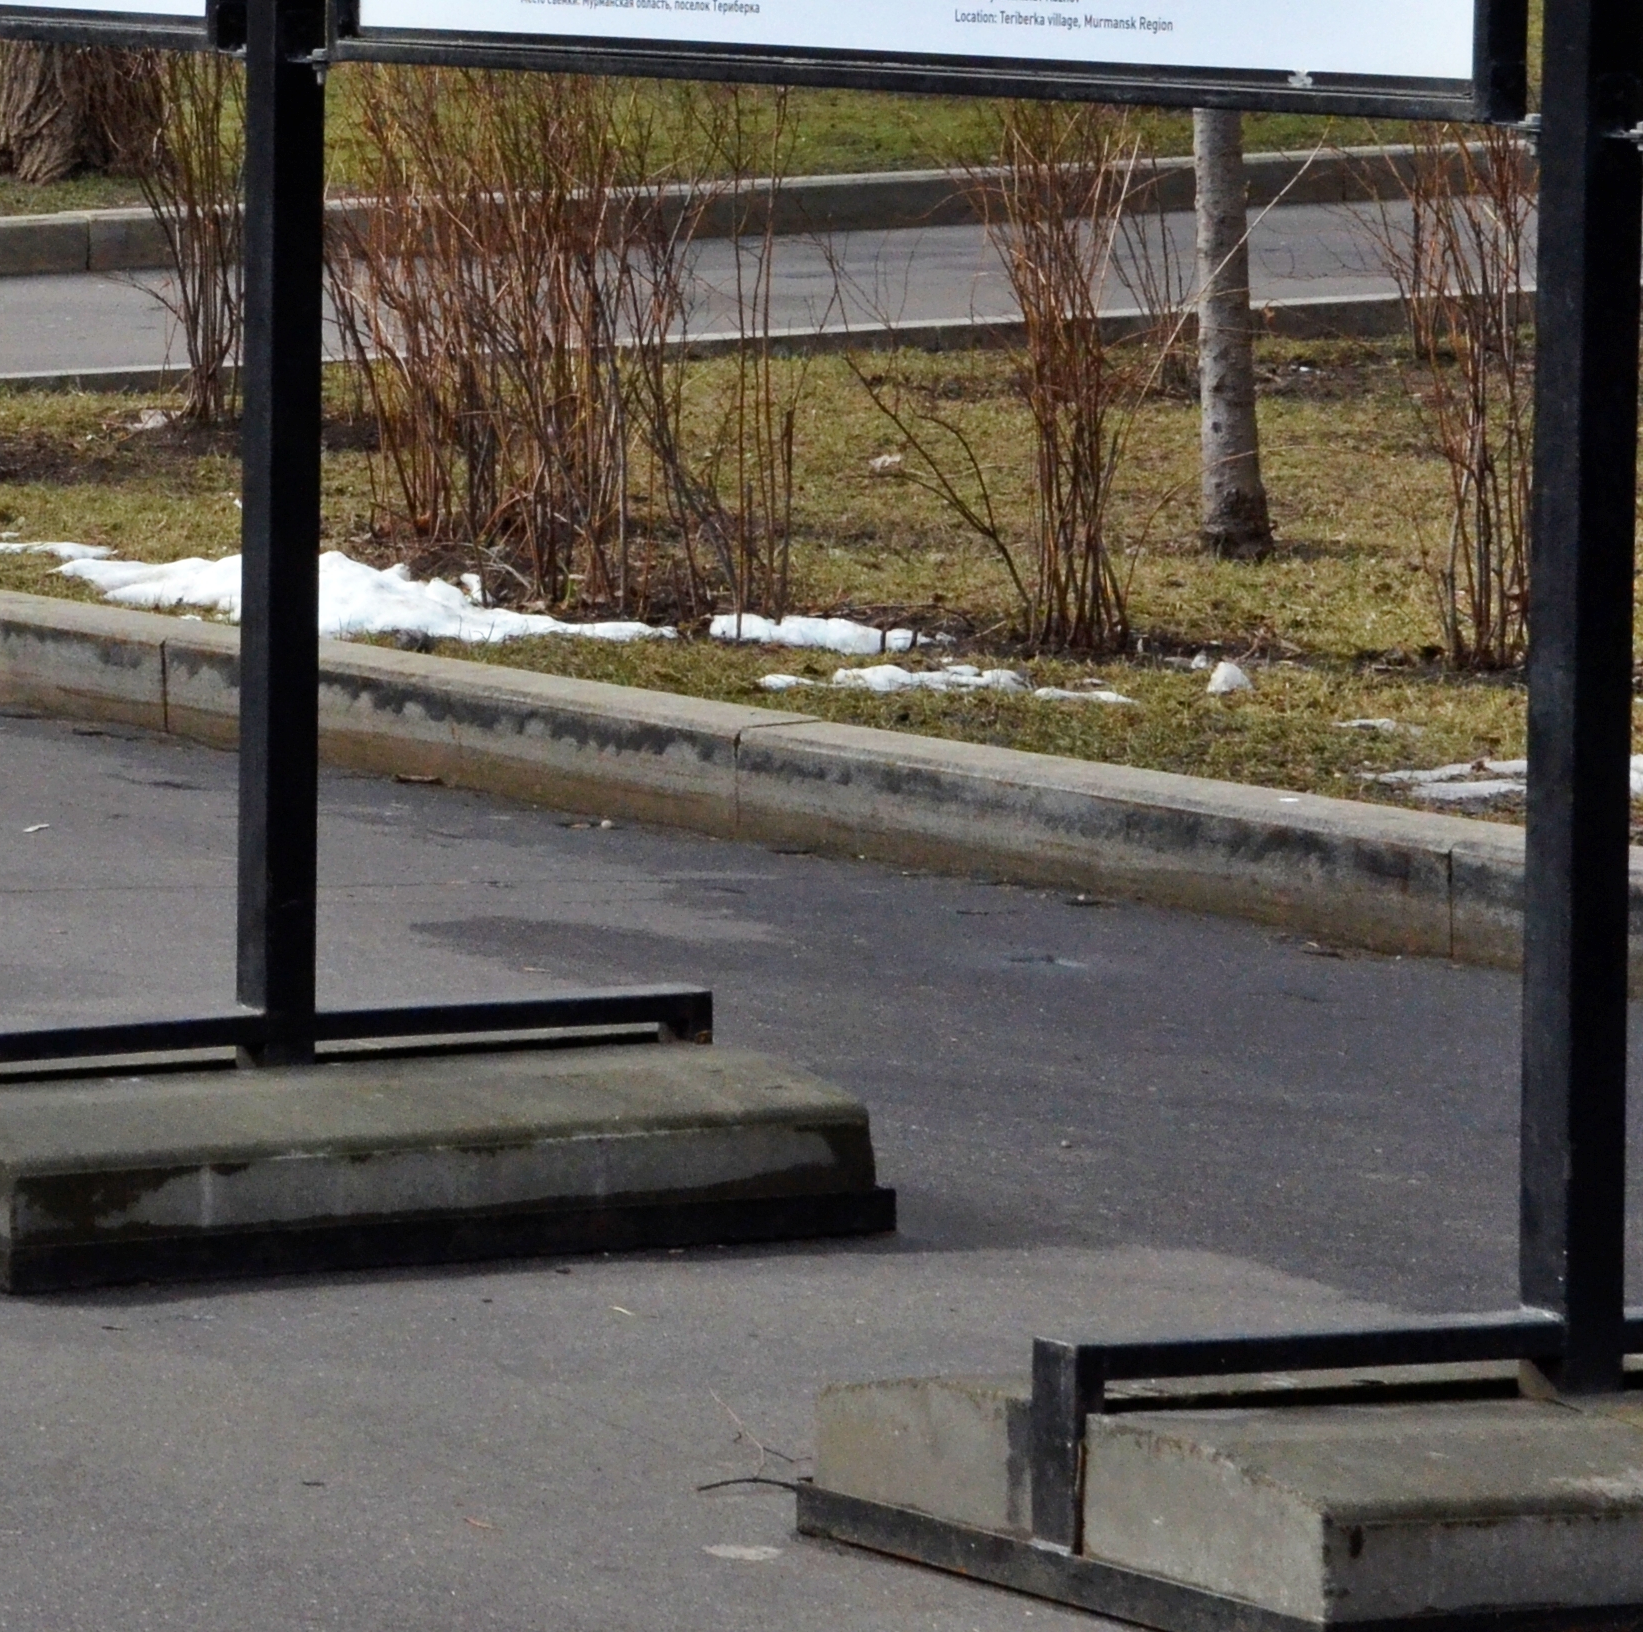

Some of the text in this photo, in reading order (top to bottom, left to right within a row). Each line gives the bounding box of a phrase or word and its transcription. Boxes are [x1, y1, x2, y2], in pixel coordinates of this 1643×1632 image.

[674, 0, 711, 12] поселок
[954, 9, 1173, 34] Location: Teriberka village, Murmansk Region
